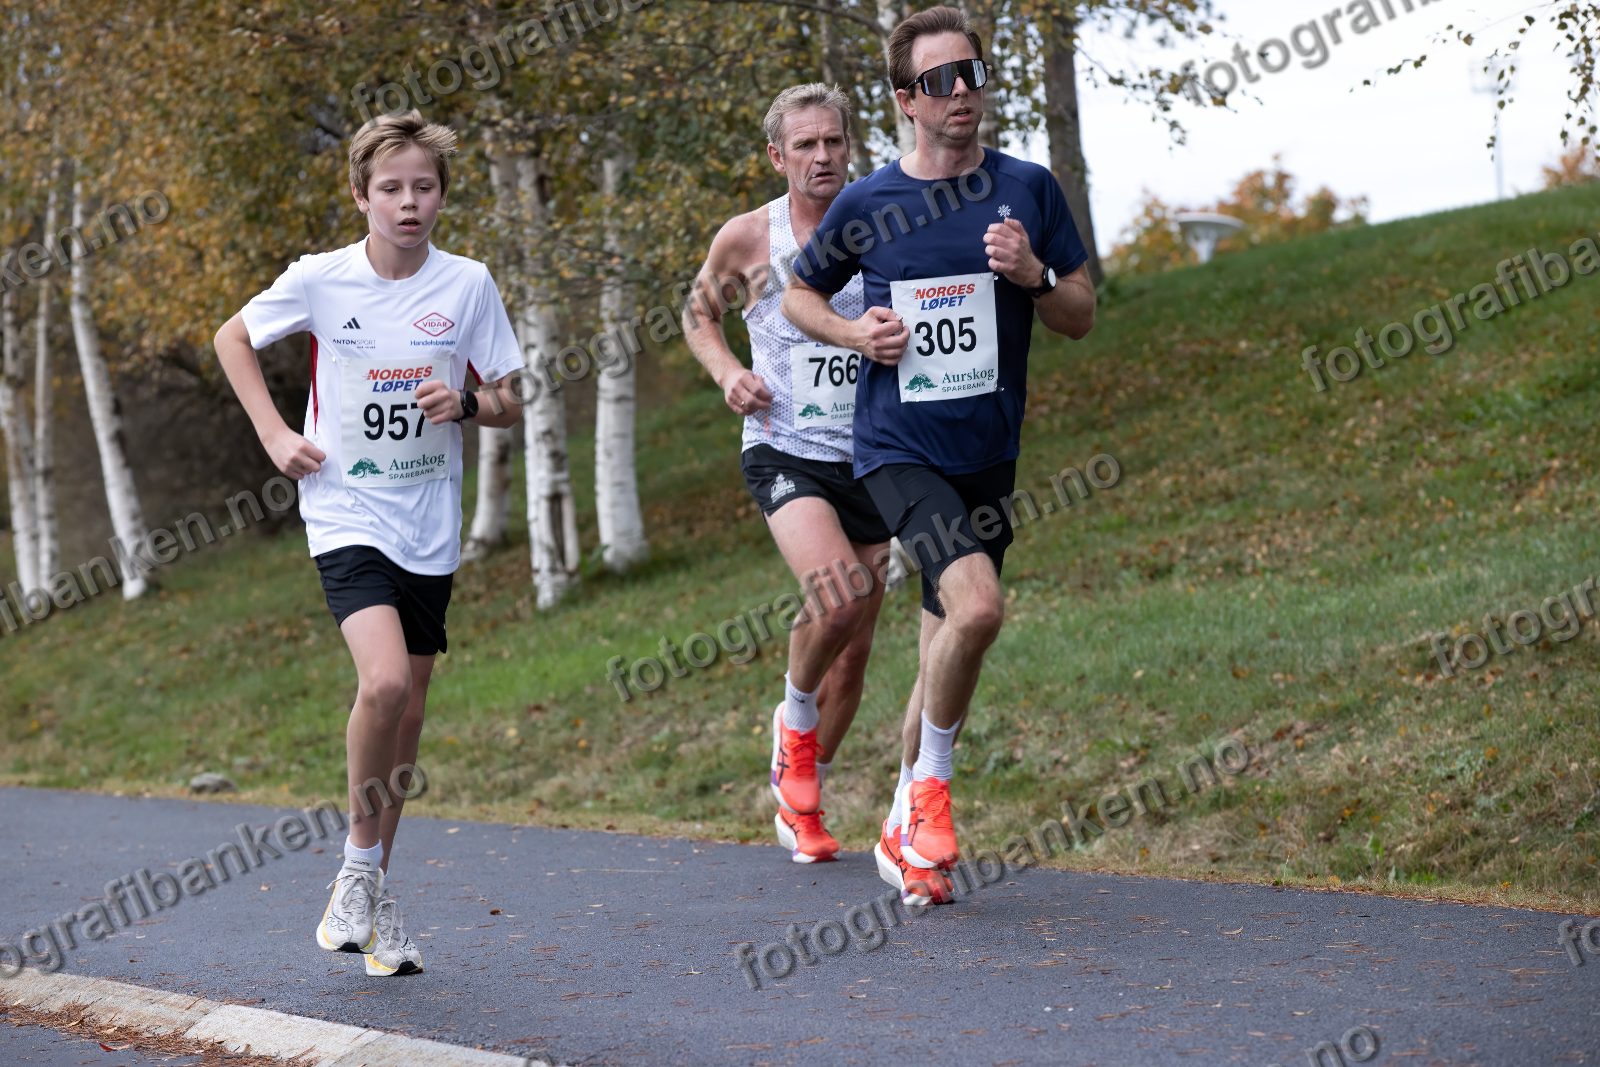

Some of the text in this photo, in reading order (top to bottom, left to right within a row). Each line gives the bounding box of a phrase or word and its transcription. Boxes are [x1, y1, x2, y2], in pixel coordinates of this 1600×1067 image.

[914, 283, 976, 299] NORGES
[921, 296, 966, 310] LØPET
[914, 316, 977, 357] 305
[366, 366, 433, 380] NORGES
[808, 353, 860, 387] 766
[942, 368, 995, 384] Aurskog
[372, 379, 424, 393] LØPET
[942, 381, 986, 393] SPAREBANK
[363, 403, 426, 441] 957
[389, 453, 446, 471] Aurskog
[388, 468, 435, 480] SPAREBANK
